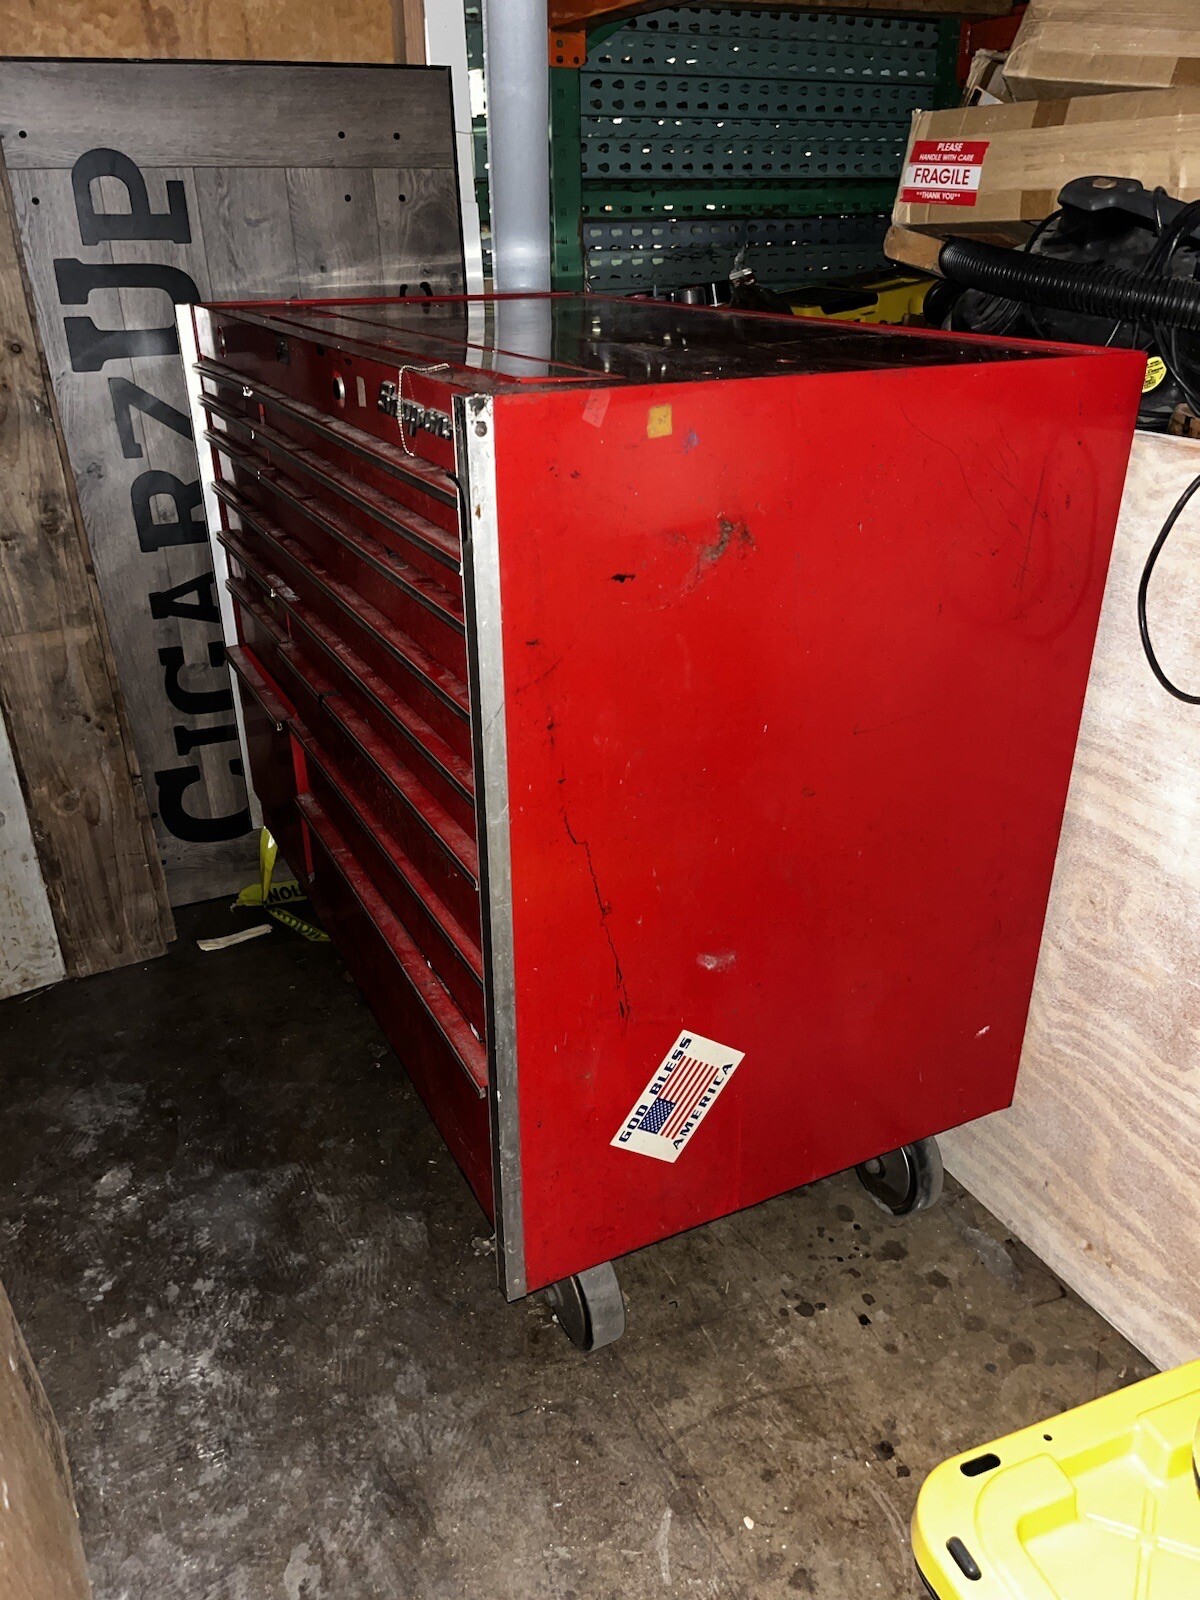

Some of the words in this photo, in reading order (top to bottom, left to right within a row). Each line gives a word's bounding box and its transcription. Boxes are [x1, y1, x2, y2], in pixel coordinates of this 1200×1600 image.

[936, 142, 963, 152] PLEASE
[919, 153, 942, 162] HANDLE
[942, 153, 957, 162] WITH
[957, 153, 975, 162] CARE
[913, 167, 971, 186] FRAGILE
[618, 1104, 649, 1143] GOD
[649, 1036, 692, 1096] BLESS
[672, 1063, 734, 1150] AMERICA
